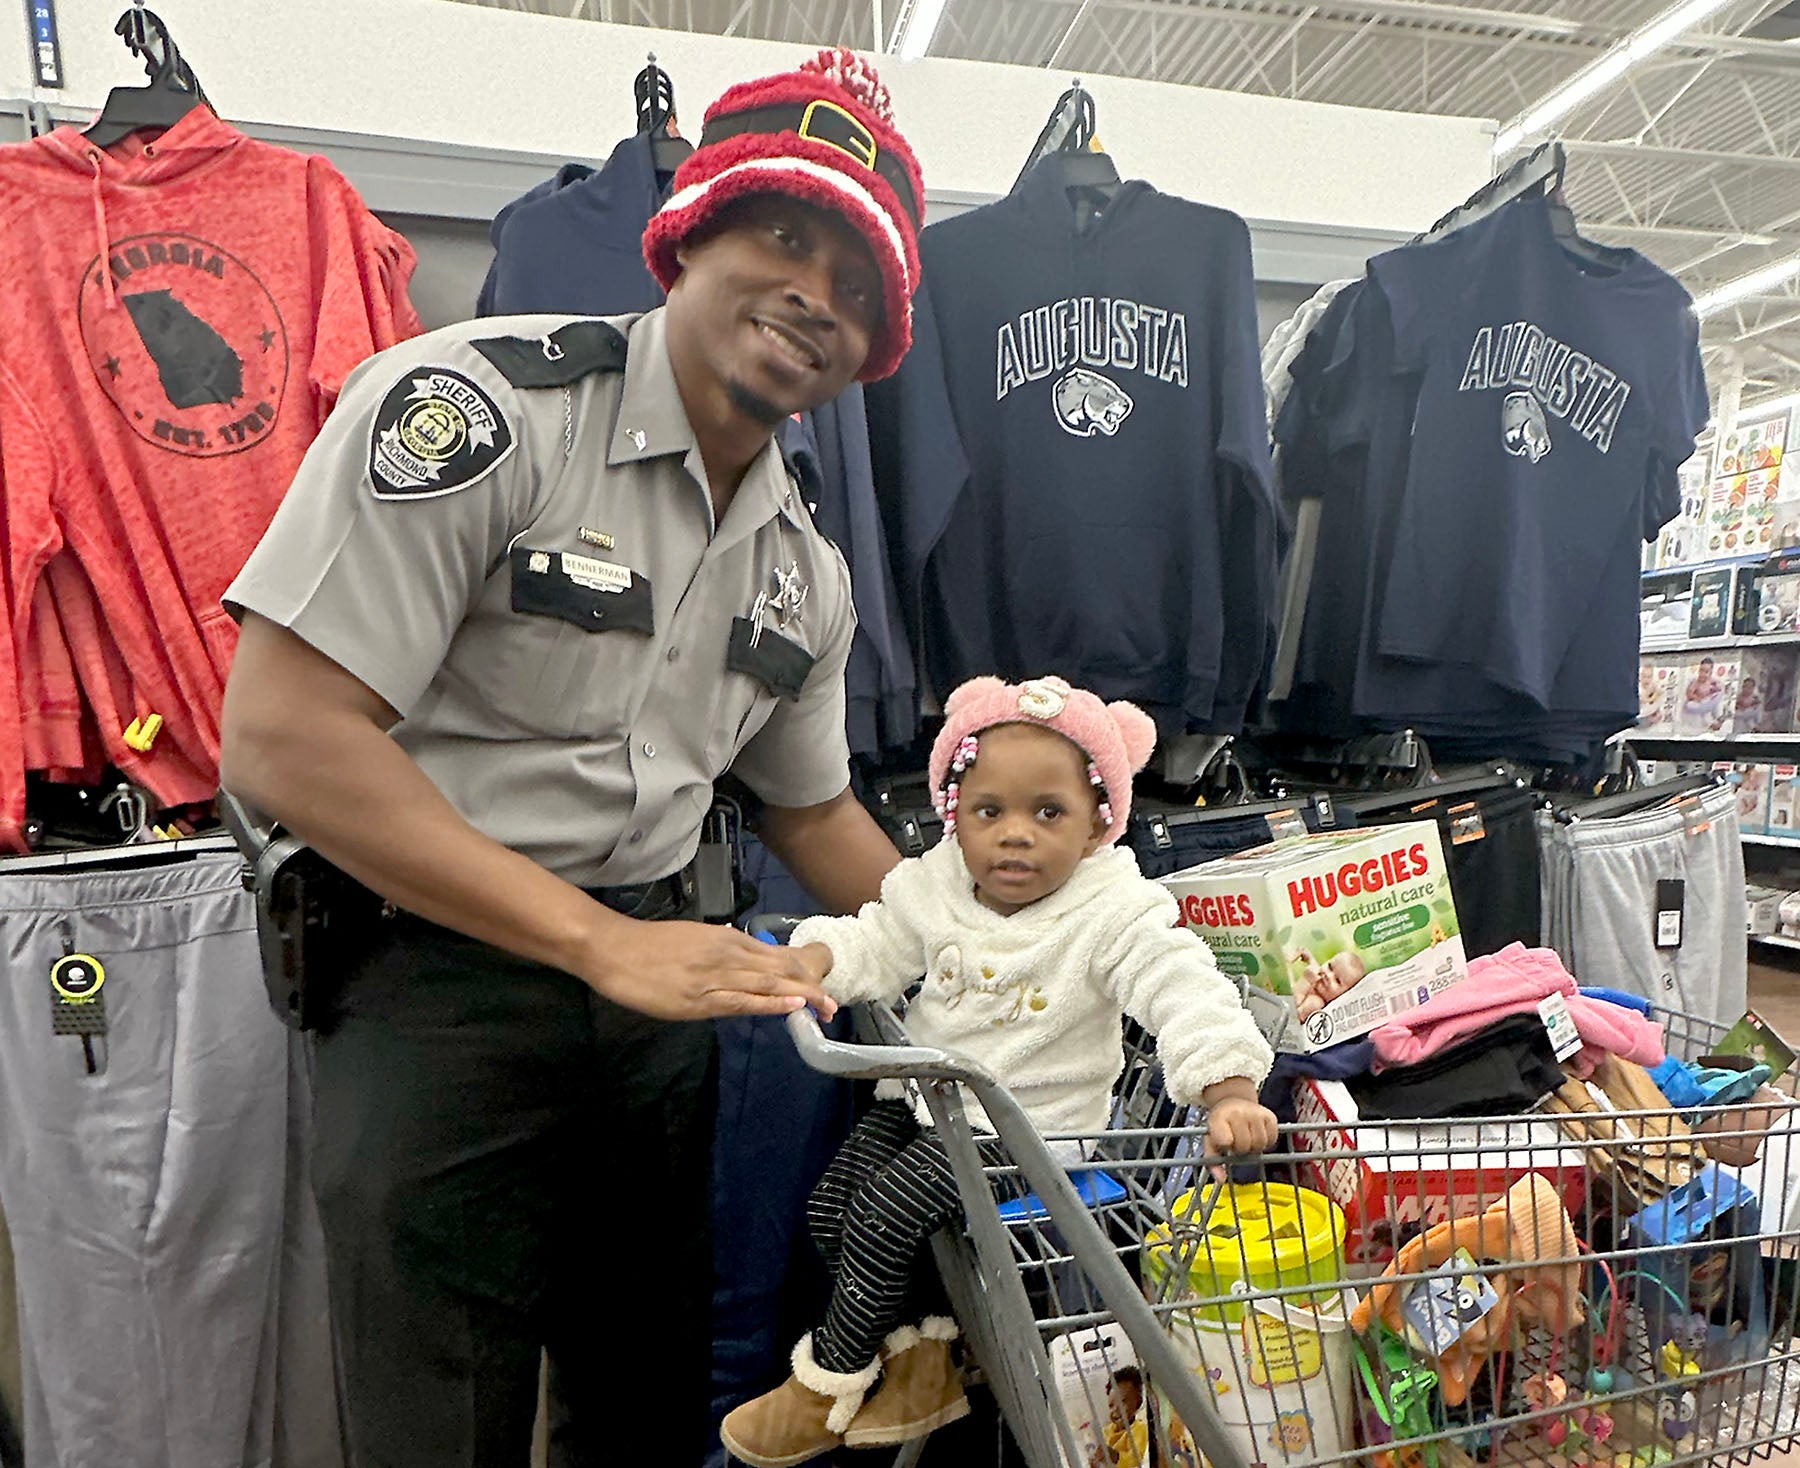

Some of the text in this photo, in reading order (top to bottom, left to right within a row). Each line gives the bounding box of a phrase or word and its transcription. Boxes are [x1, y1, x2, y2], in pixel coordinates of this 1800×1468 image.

[35, 8, 48, 18] 28
[41, 28, 48, 37] 3
[997, 296, 1188, 401] AUGUSTA
[430, 378, 493, 431] SHERIFF
[1459, 322, 1631, 454] AUGUSTA
[376, 460, 406, 485] COUNTY
[384, 438, 429, 477] RICHMOND
[565, 558, 628, 581] BENNERMAN
[1287, 843, 1429, 918] HUGGIES
[1340, 881, 1435, 926] natural care
[1233, 935, 1261, 948] care
